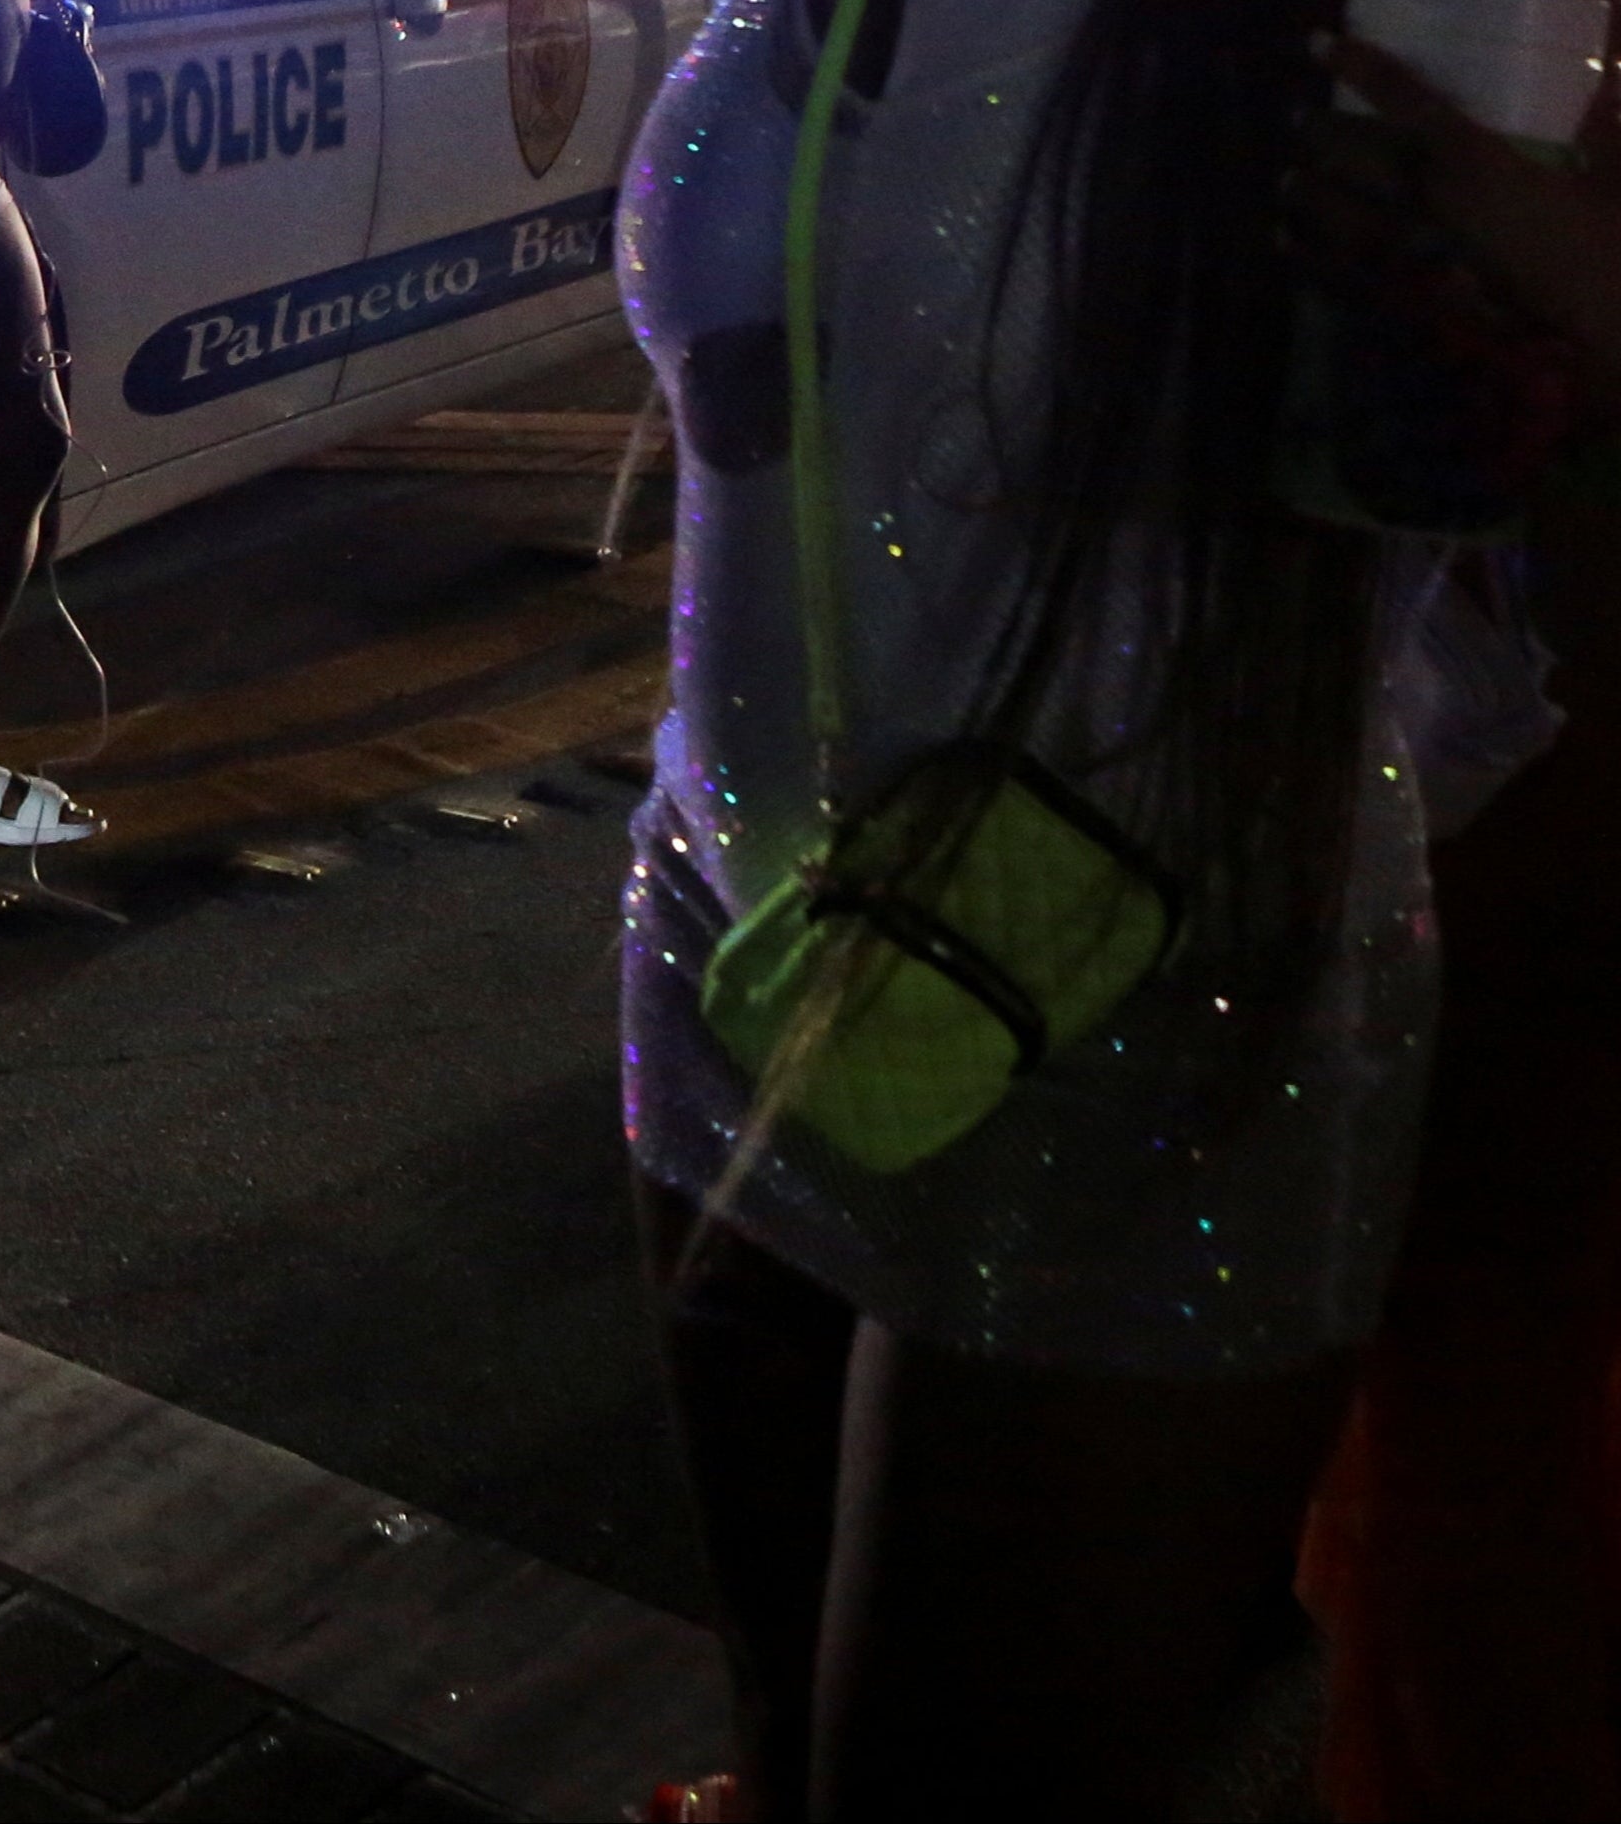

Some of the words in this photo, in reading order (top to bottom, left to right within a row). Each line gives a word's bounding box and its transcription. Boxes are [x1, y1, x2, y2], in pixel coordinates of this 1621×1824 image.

[126, 40, 347, 183] POLICE
[182, 256, 480, 382] Palmetto
[508, 214, 612, 277] Bay
